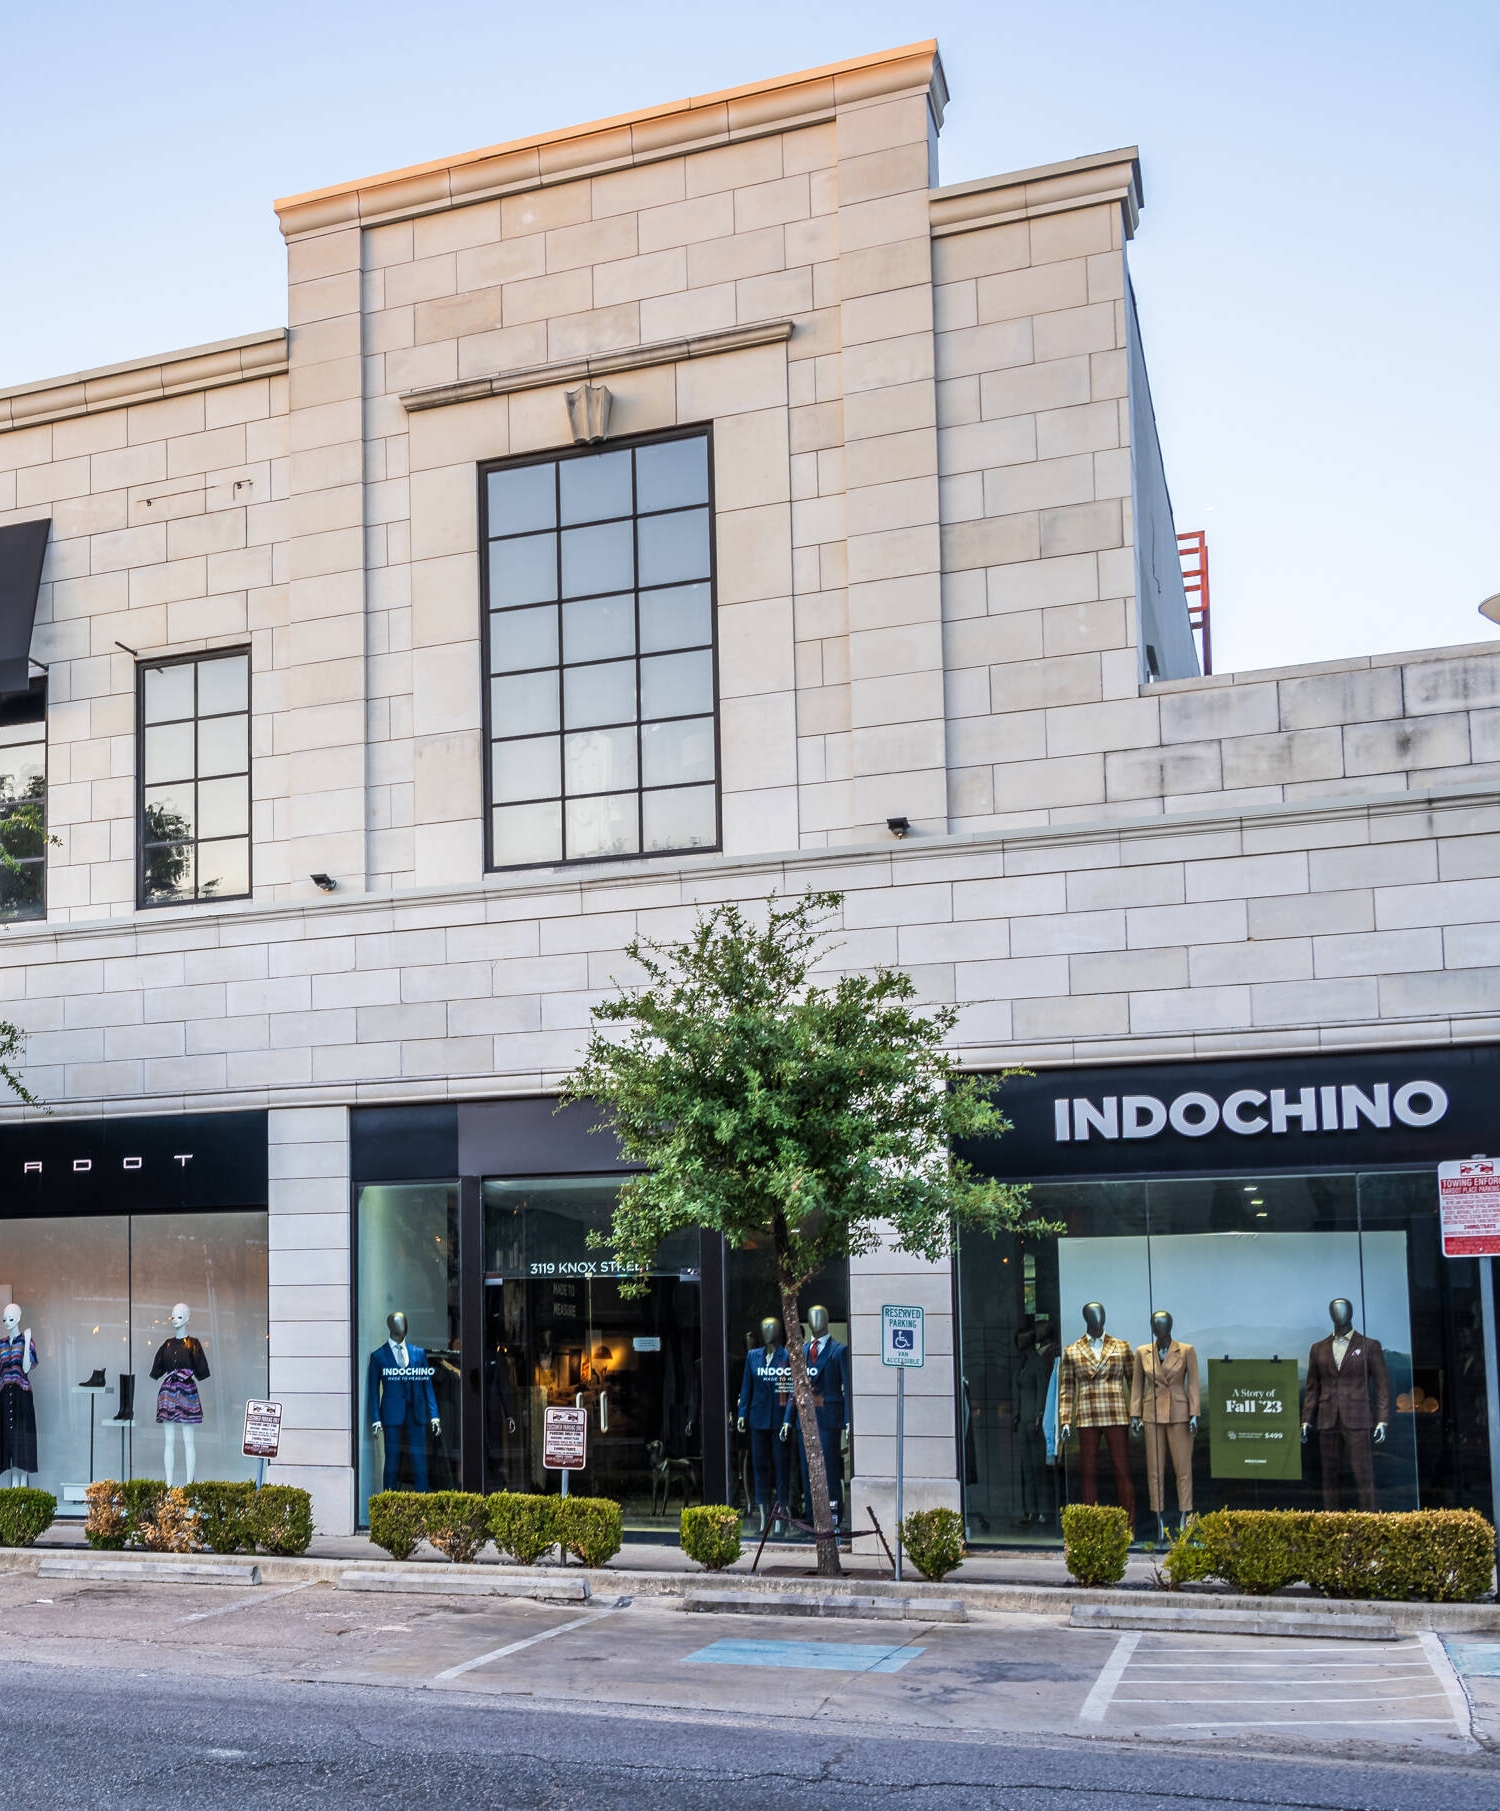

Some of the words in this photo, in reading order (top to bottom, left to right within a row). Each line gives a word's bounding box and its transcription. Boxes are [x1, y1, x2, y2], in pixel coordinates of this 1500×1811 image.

[1054, 1080, 1448, 1142] INDOCHINO
[1443, 1178, 1473, 1188] TOWING
[1473, 1176, 1500, 1187] ENFOR
[530, 1262, 556, 1275] 3119
[558, 1261, 598, 1274] KNOX
[552, 1283, 568, 1297] MADE
[568, 1284, 576, 1297] TO
[553, 1302, 577, 1317] MEASURE
[885, 1308, 921, 1319] RESERVED
[889, 1319, 917, 1329] PARKING
[382, 1367, 435, 1376] INDOCHINO
[757, 1367, 818, 1376] INDOCO
[1231, 1388, 1240, 1397] A
[1241, 1388, 1264, 1399] Story
[1266, 1388, 1276, 1397] of
[1226, 1400, 1256, 1413] Fall
